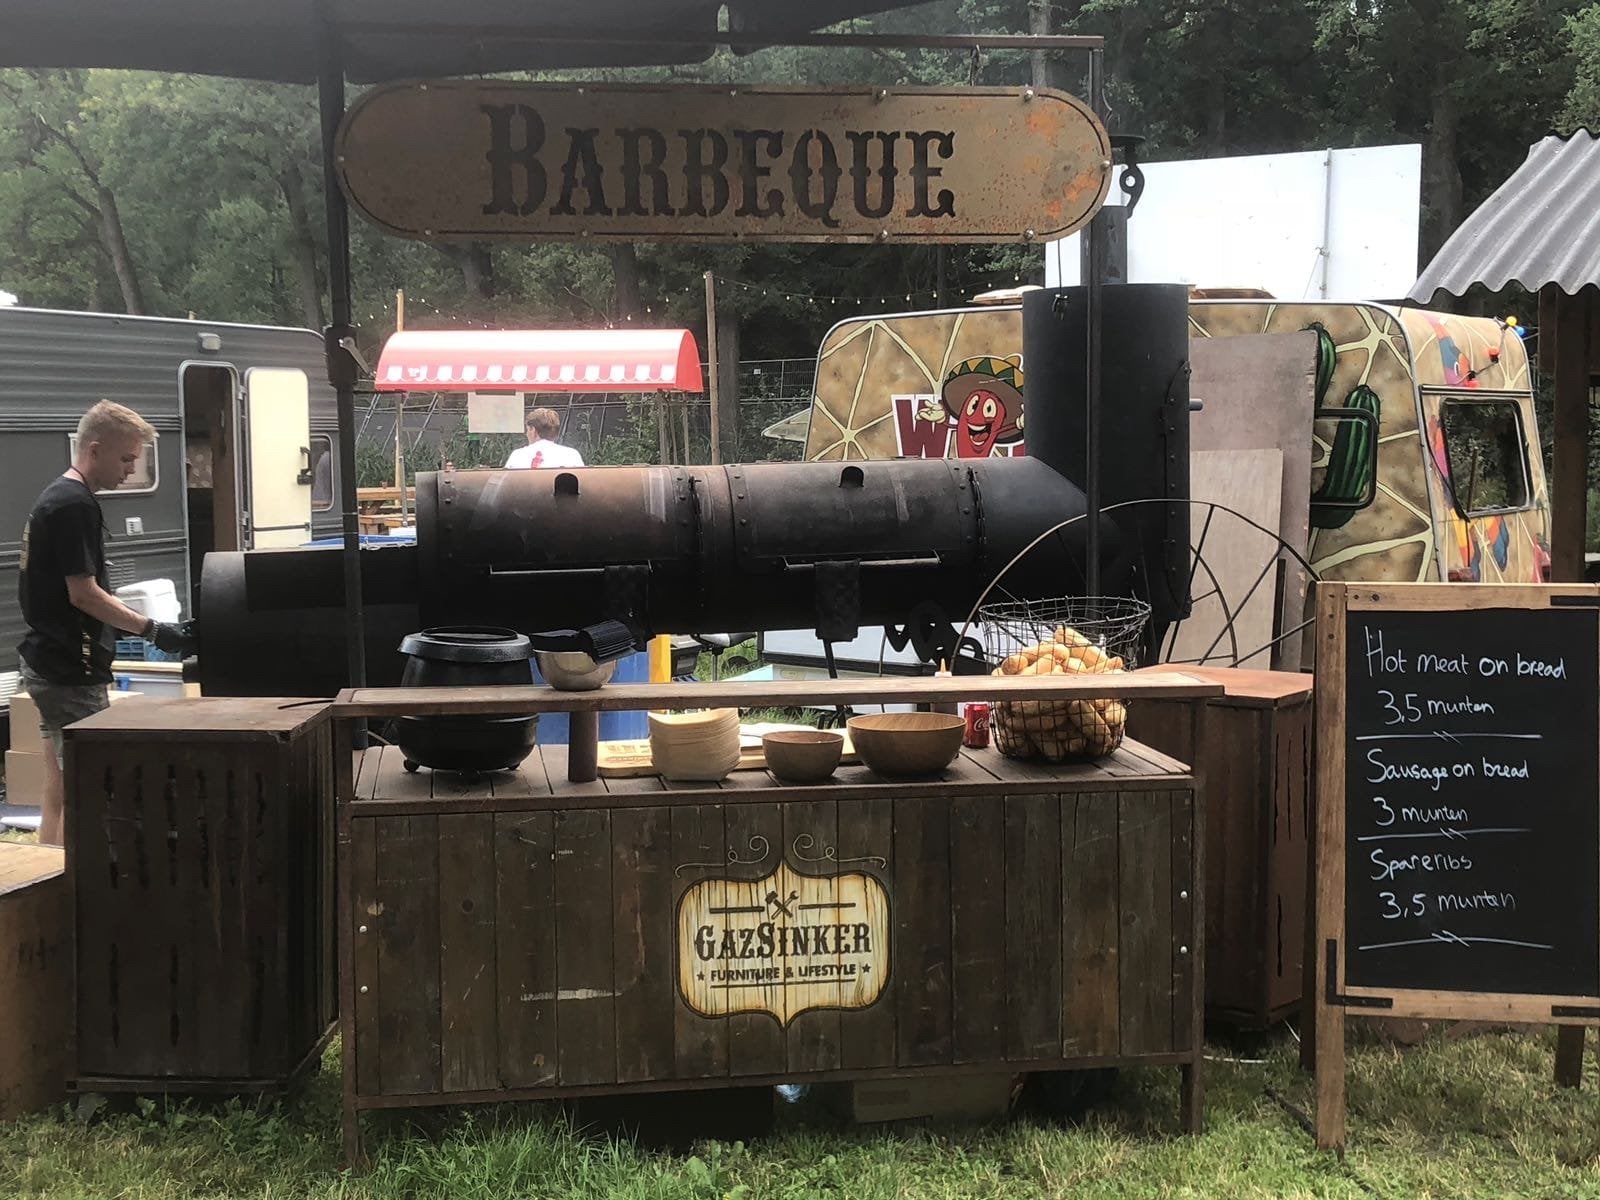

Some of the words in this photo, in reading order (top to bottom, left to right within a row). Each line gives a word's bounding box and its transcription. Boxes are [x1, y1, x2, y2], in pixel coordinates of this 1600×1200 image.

[479, 103, 957, 228] BARBEQUE
[1365, 625, 1407, 677] Hot
[1479, 656, 1509, 677] on
[1516, 652, 1567, 680] bread
[1377, 690, 1422, 725] 3,5
[1366, 748, 1449, 791] Sausage
[1452, 762, 1476, 778] on
[1482, 756, 1530, 779] bread
[1372, 797, 1396, 826] 3
[1402, 805, 1469, 823] munten
[1370, 849, 1473, 881] Spareribs
[1378, 891, 1427, 919] 3,5
[1438, 889, 1517, 912] munten
[710, 966, 780, 982] FURNITURE
[786, 966, 794, 978] &
[798, 963, 857, 977] LIFESTYLE
